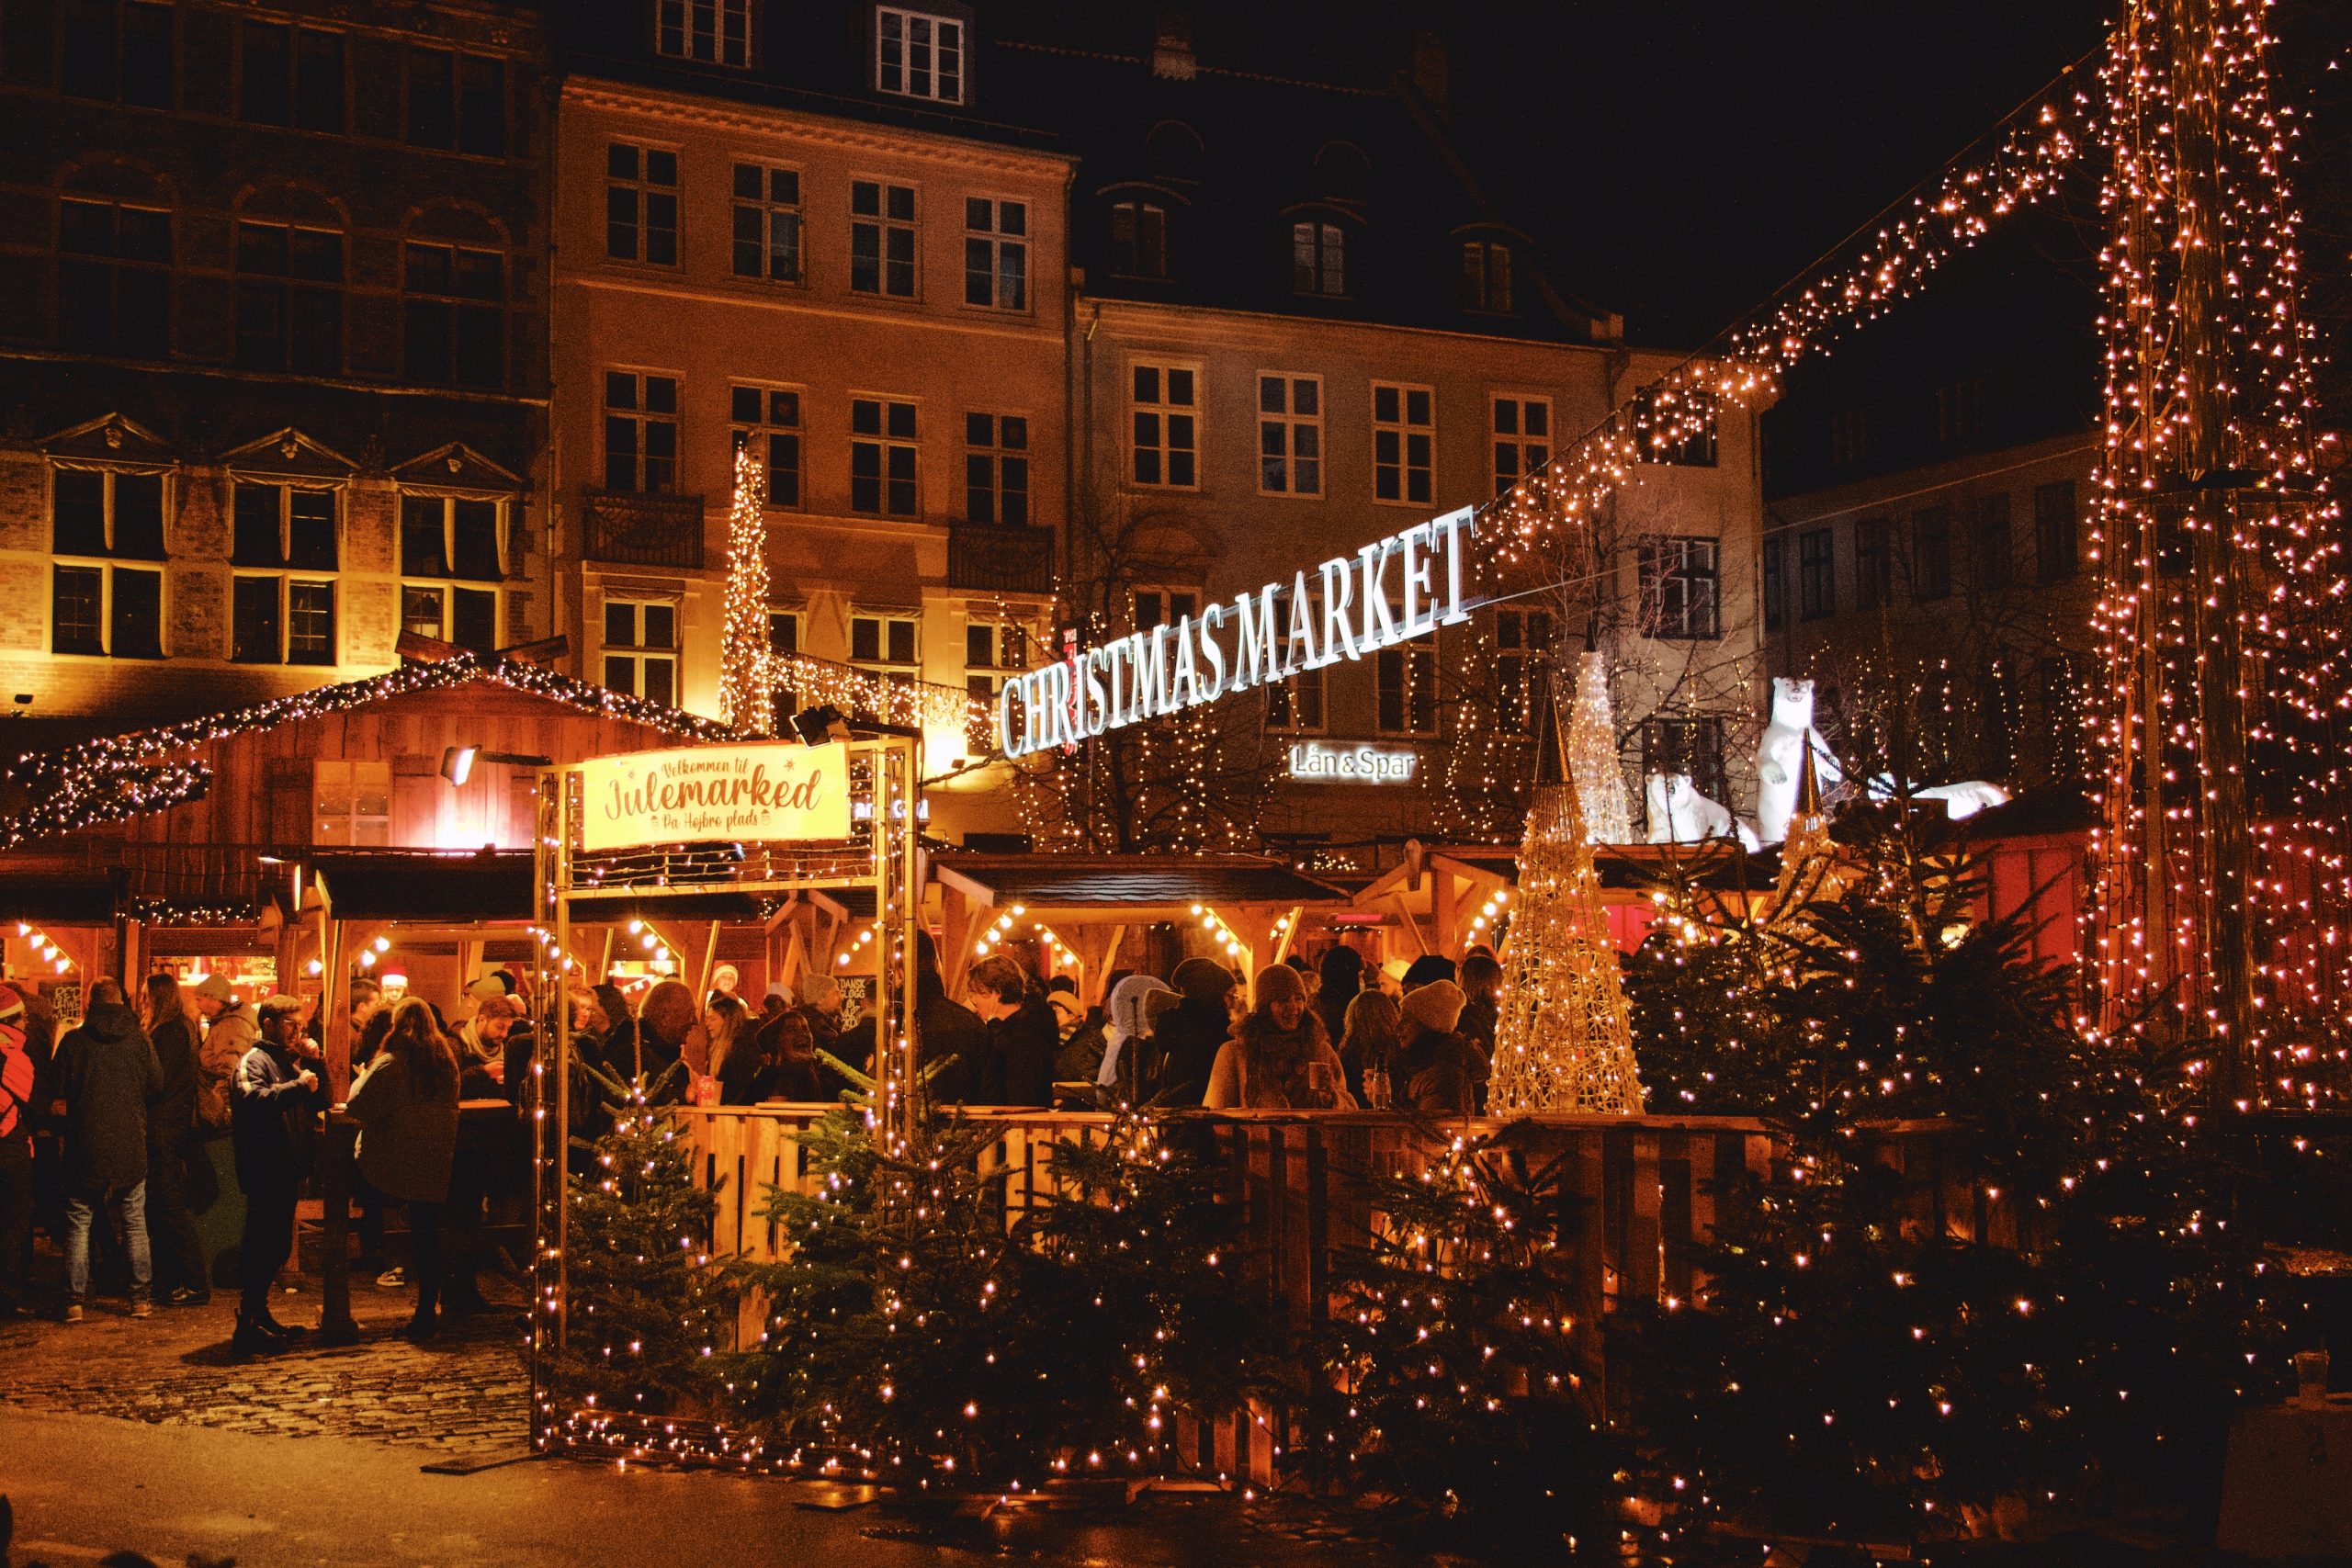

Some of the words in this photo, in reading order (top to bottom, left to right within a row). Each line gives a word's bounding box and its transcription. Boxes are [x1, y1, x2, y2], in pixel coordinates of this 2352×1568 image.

[1000, 603, 1226, 759] CHRISTMAS
[1231, 504, 1477, 693] MARKET
[662, 759, 731, 779] Velkommen
[734, 756, 749, 775] til
[605, 763, 822, 820] Julemarked
[726, 808, 758, 832] plads
[839, 978, 866, 989] DANSK
